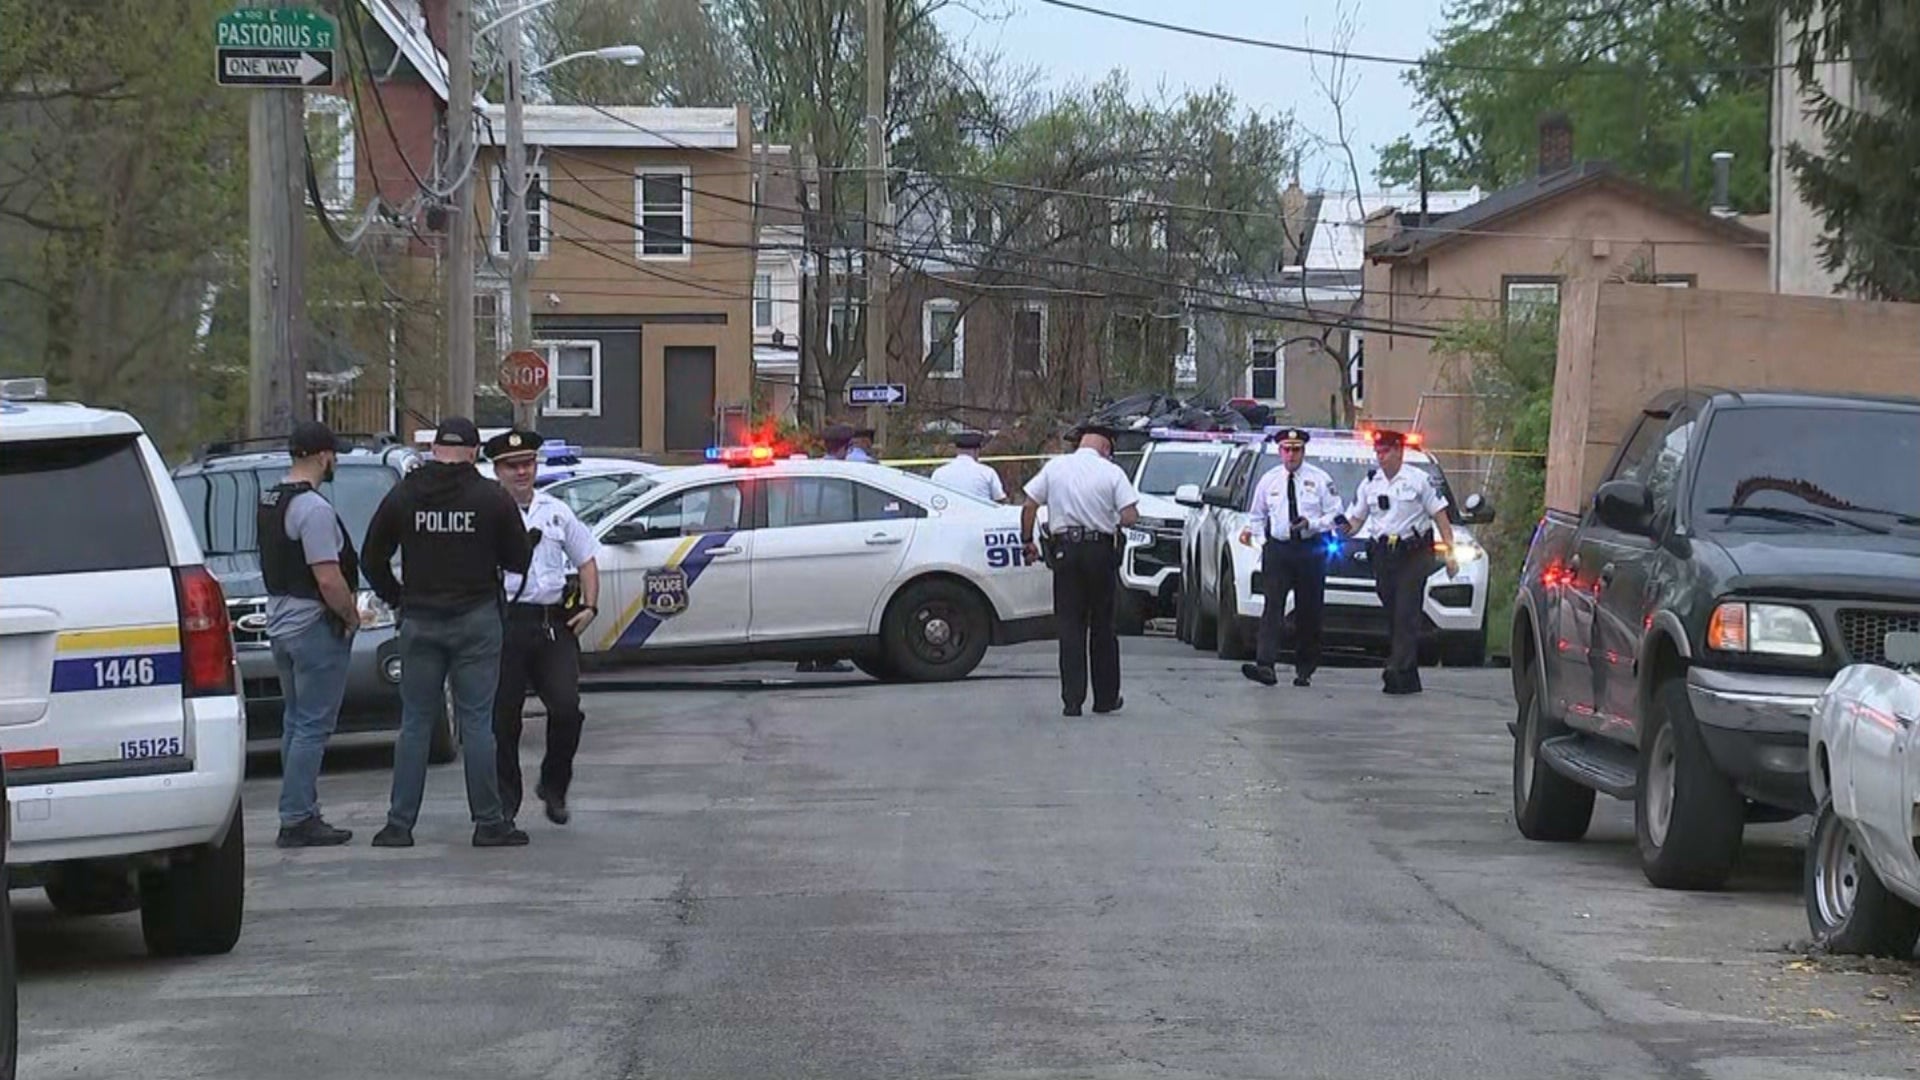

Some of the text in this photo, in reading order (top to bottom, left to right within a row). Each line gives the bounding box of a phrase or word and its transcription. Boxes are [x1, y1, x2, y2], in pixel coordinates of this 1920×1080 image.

[219, 22, 331, 48] PASTORIUS ST
[229, 59, 298, 75] ONE WAY
[500, 366, 547, 386] STOP
[415, 511, 476, 533] POLICE
[984, 533, 1023, 547] DIA
[648, 578, 682, 593] POLICE
[94, 657, 154, 687] 1446
[120, 737, 180, 760] 155125
